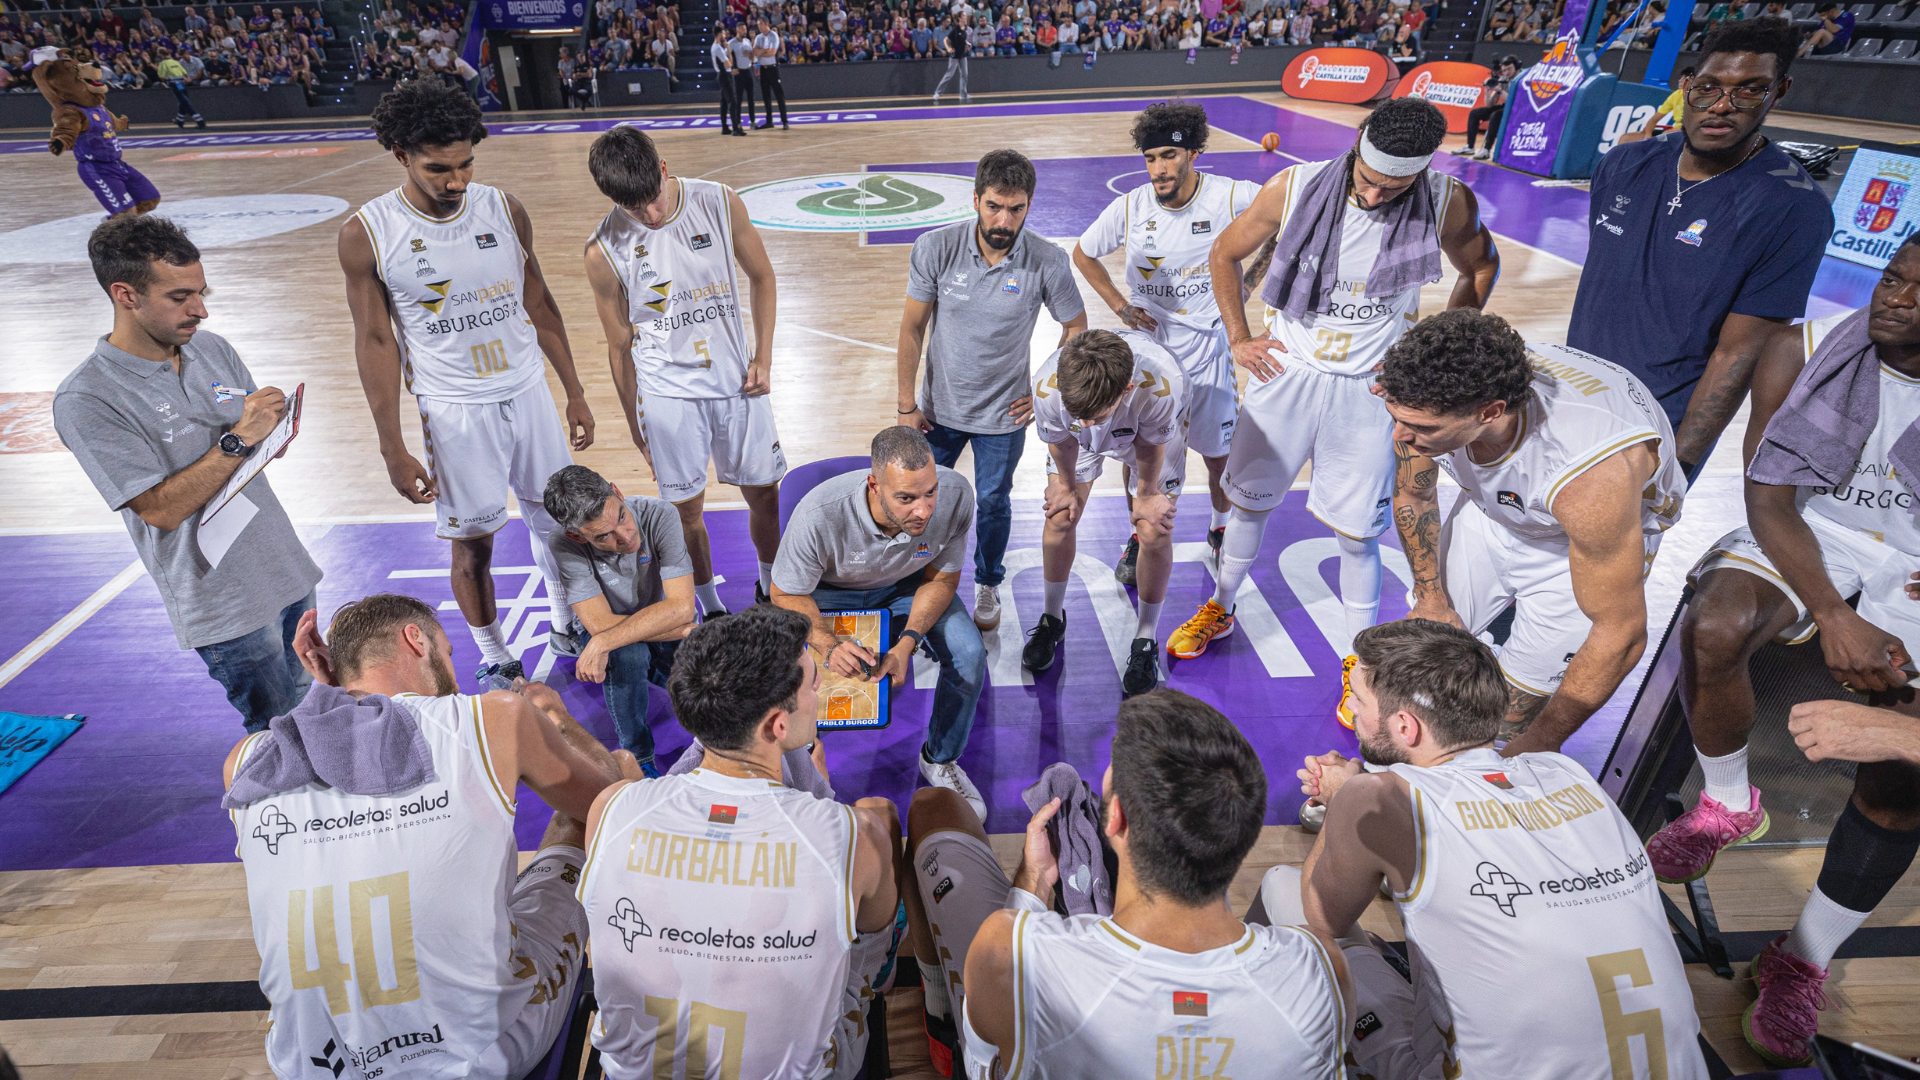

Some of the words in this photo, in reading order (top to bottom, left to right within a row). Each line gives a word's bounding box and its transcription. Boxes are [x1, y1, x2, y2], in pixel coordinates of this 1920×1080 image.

[507, 0, 566, 15] BIENVENIDOS
[1317, 65, 1369, 74] BALONCESTO
[1349, 73, 1366, 81] LEÓN
[1528, 62, 1585, 86] PALENCIA
[1425, 92, 1452, 103] CASTILLA
[1452, 96, 1457, 104] Y
[1457, 95, 1475, 105] LEÓN
[1428, 83, 1480, 96] BALONCESTO
[502, 123, 582, 133] de
[1516, 121, 1546, 136] JUEGA
[1508, 135, 1548, 150] PALENCIA
[1160, 262, 1210, 280] SANpab
[1146, 281, 1209, 298] BURGOS
[438, 304, 510, 334] BURGOS
[664, 304, 726, 331] BURGOS
[693, 339, 711, 369] 5
[1314, 329, 1353, 362] 23
[470, 339, 509, 378] 00
[304, 807, 392, 833] recoletas
[399, 790, 449, 817] salud
[626, 827, 797, 888] CORBALÁN
[1539, 867, 1626, 895] recoletas
[1625, 847, 1649, 877] salud
[287, 870, 422, 1018] 40
[659, 926, 755, 950] recoletas
[762, 929, 817, 950] salud
[1356, 1013, 1376, 1029] acb
[1586, 947, 1668, 1080] 6
